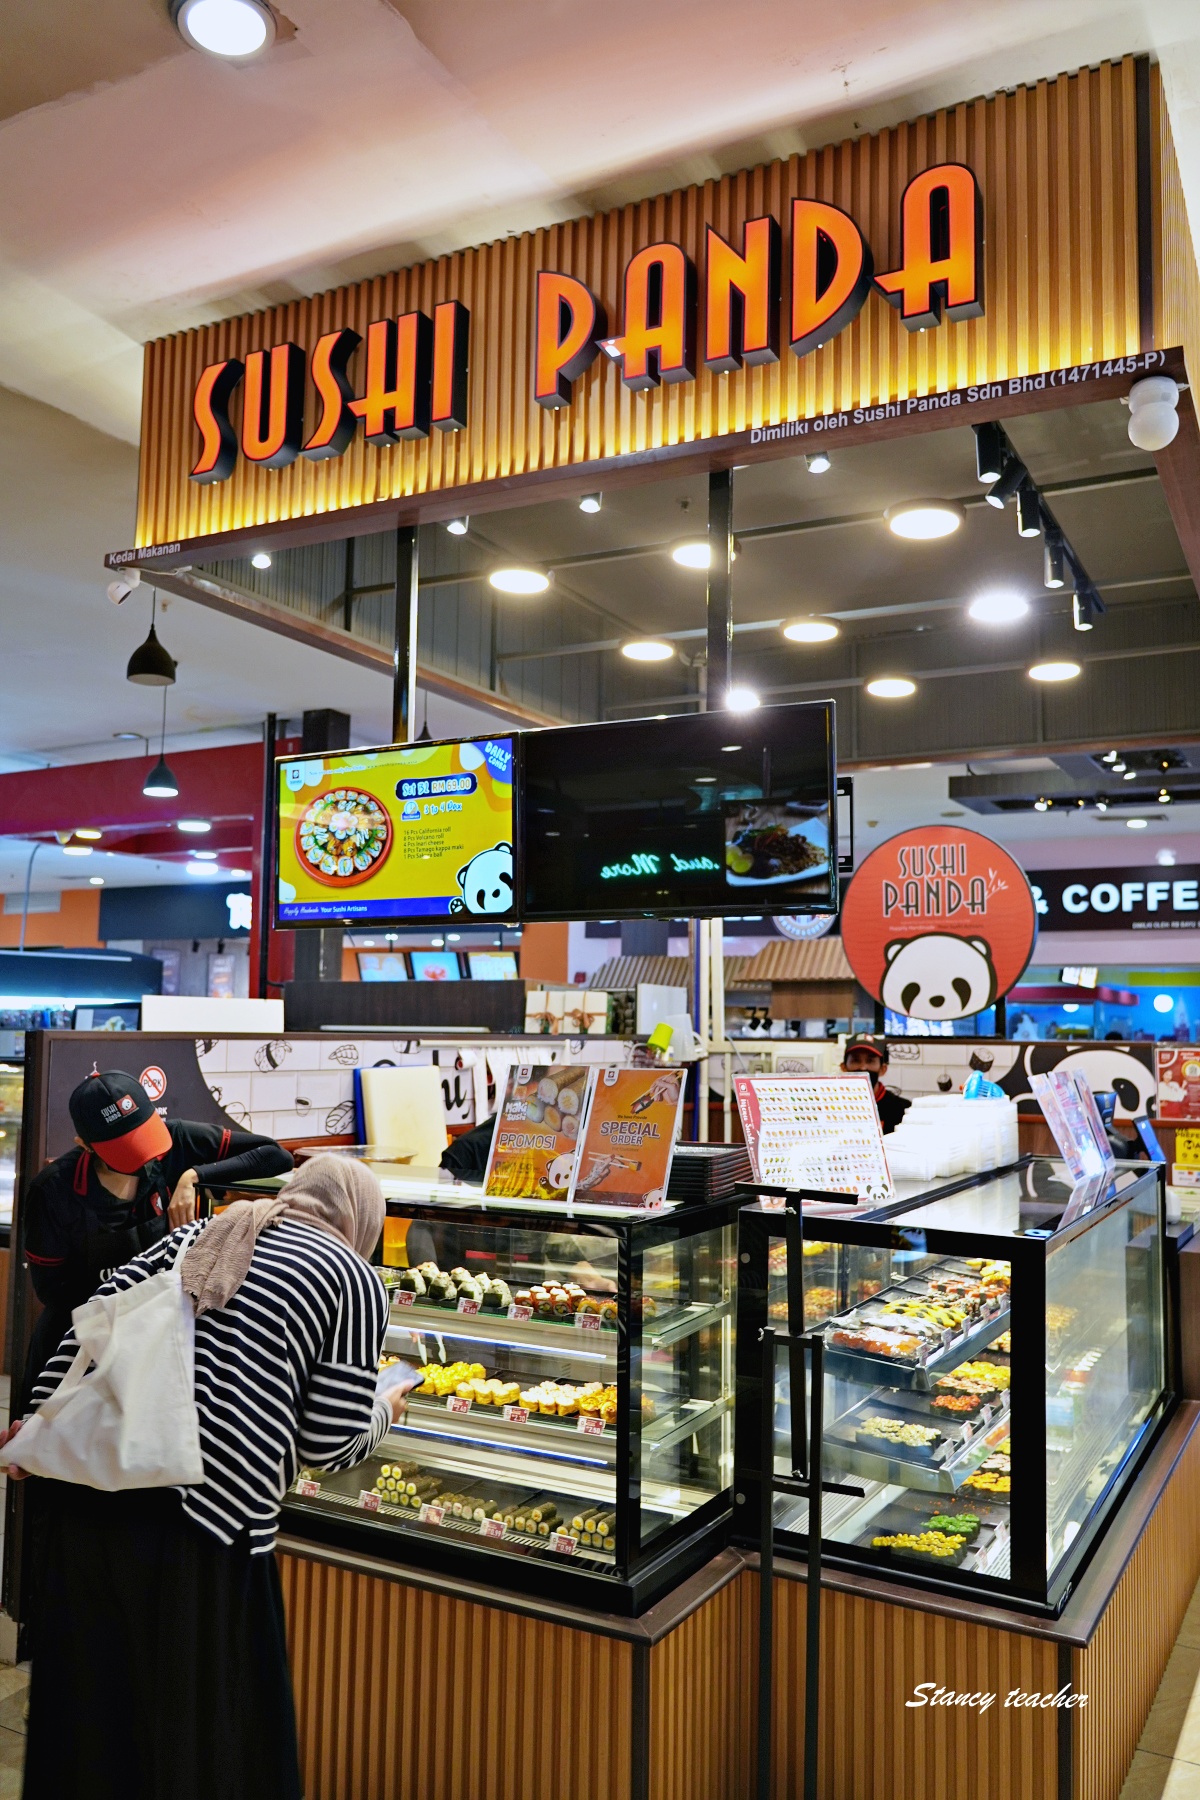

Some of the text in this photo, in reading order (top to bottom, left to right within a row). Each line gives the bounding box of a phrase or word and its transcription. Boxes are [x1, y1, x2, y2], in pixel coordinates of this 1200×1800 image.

[190, 161, 984, 483] SUSHI PANDA
[750, 350, 1166, 444] Dimiliki oleh Sushi Panda Sdn Bhd (1471445-P)
[109, 543, 181, 565] Kedai Makanan
[485, 741, 512, 764] DAILY
[488, 756, 507, 772] COMBO
[431, 780, 446, 793] RM
[446, 777, 472, 791] 69.00
[898, 843, 967, 879] SUSHI
[882, 876, 987, 918] PANDA
[143, 1079, 162, 1088] PORK
[101, 1104, 118, 1117] SUSHI
[506, 1102, 528, 1114] Maki
[600, 1121, 660, 1139] SPECIAL
[499, 1132, 557, 1150] PROMOSI
[610, 1134, 643, 1146] ORDER
